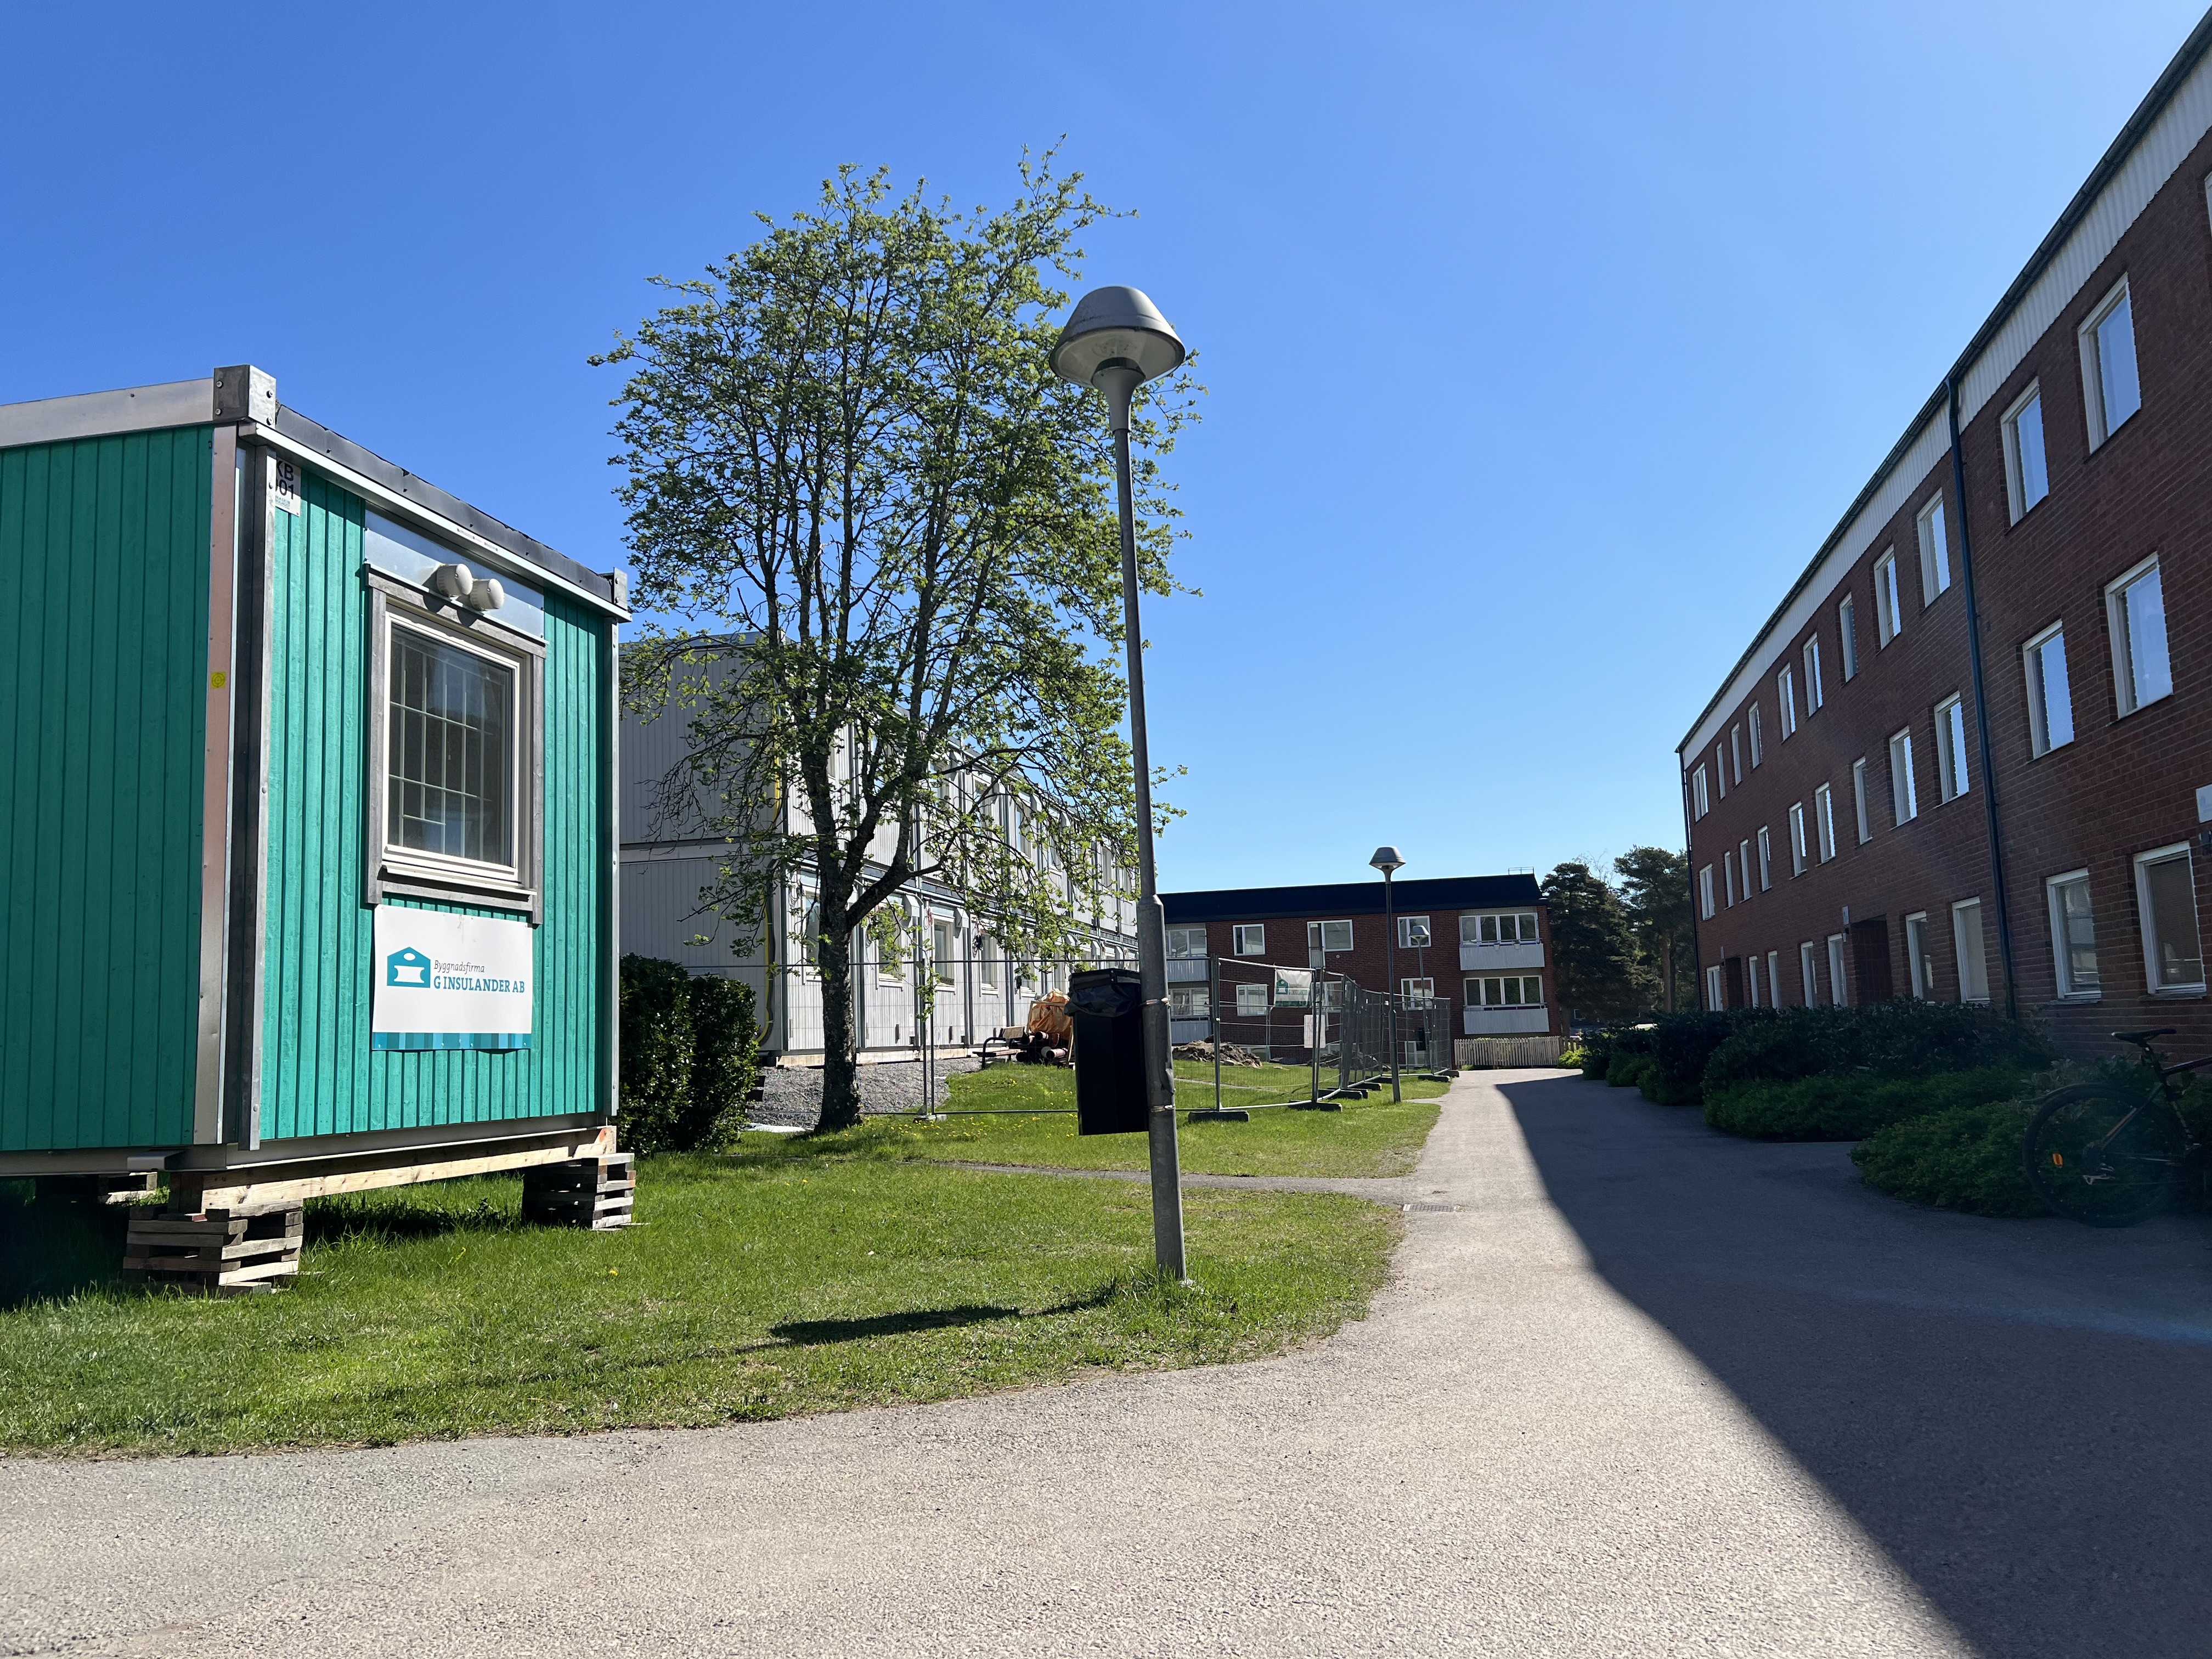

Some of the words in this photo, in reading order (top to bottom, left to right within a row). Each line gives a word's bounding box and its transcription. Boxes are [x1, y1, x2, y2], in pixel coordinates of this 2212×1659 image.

[434, 960, 485, 974] Byggnadsfirma
[434, 975, 441, 989] G
[443, 976, 510, 992] INSULANDER
[512, 980, 525, 994] AB
